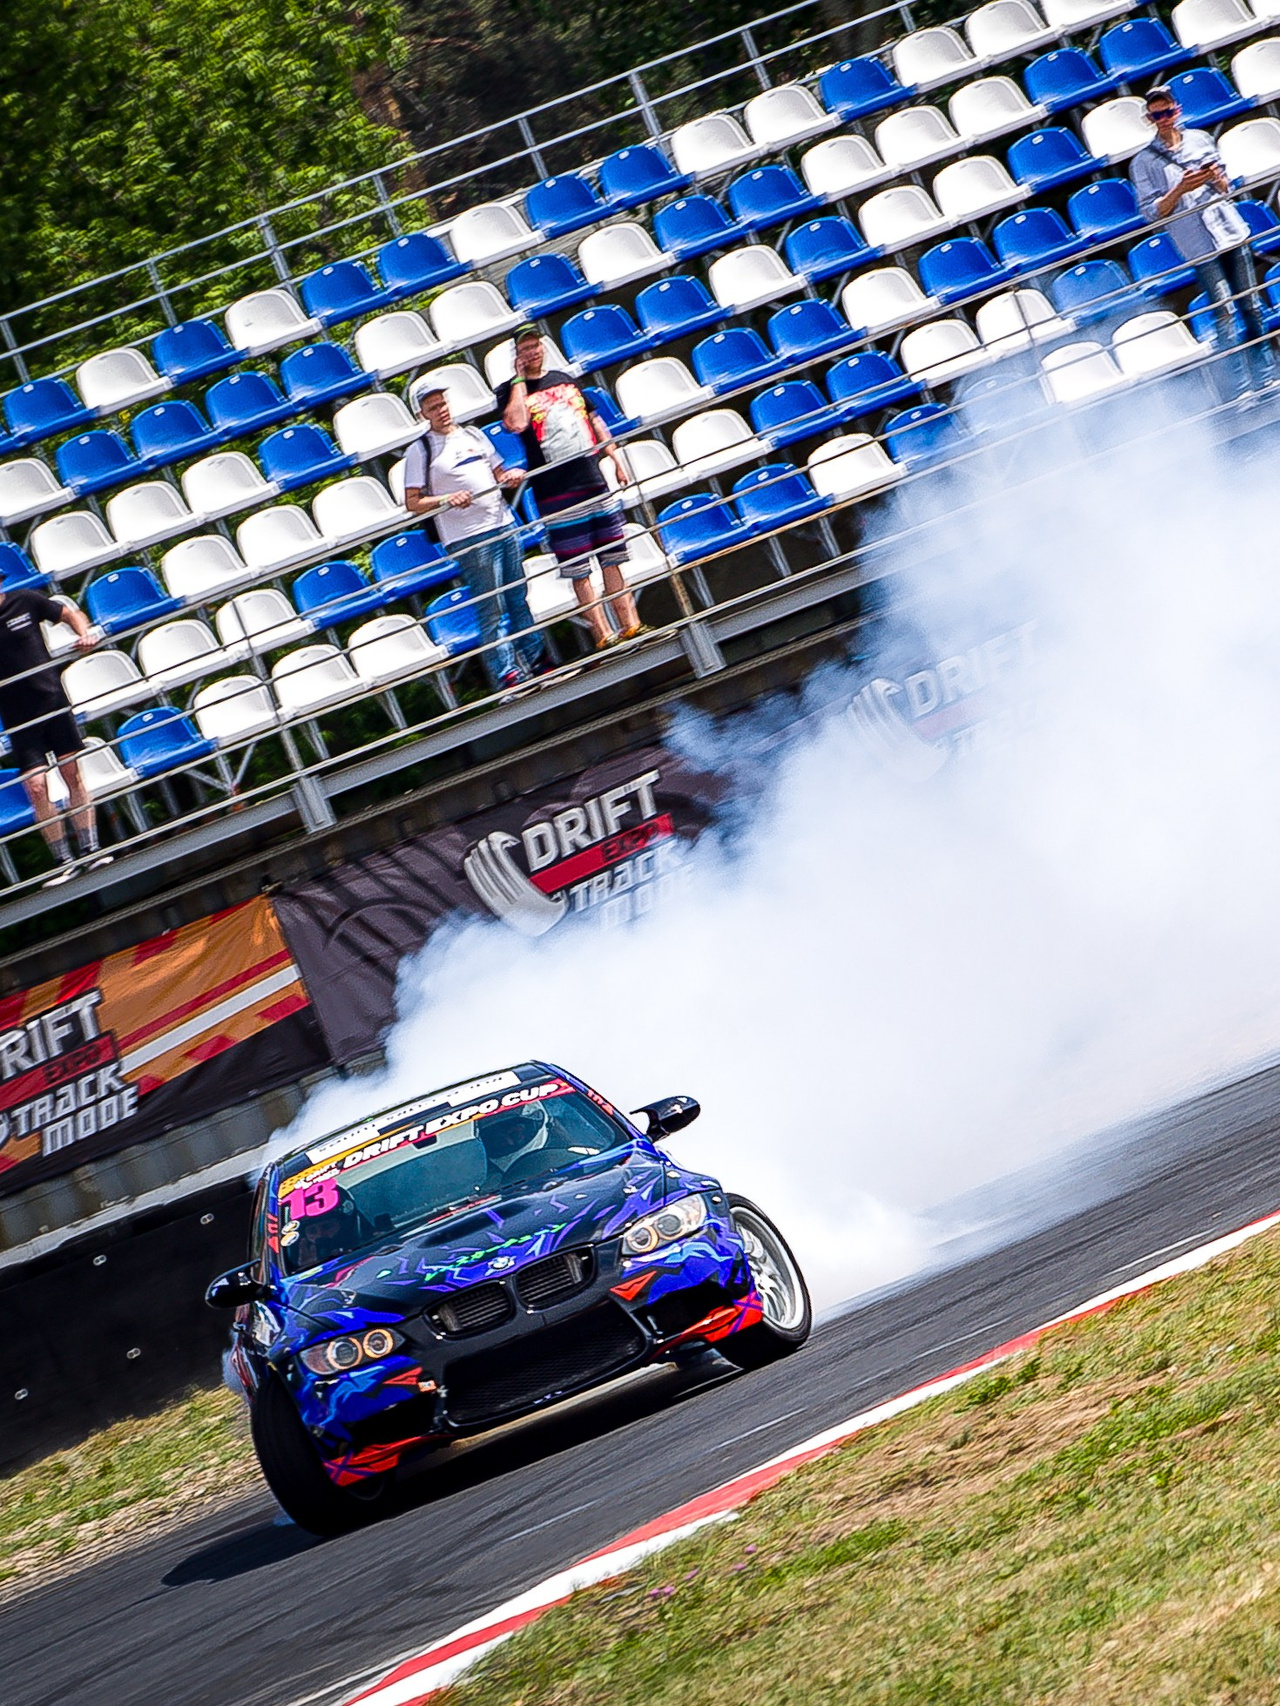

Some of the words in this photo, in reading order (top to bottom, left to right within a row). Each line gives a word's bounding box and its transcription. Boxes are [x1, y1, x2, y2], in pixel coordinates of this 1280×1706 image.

[521, 769, 661, 872] DRIFT
[569, 838, 682, 913] TRACK
[0, 988, 101, 1079] RIFT
[10, 1061, 127, 1137] TRACK
[41, 1084, 140, 1157] MODE
[343, 1124, 424, 1168] DRIFT
[425, 1098, 499, 1134] EXPO
[501, 1083, 560, 1106] CUP
[281, 1178, 339, 1220] 13
